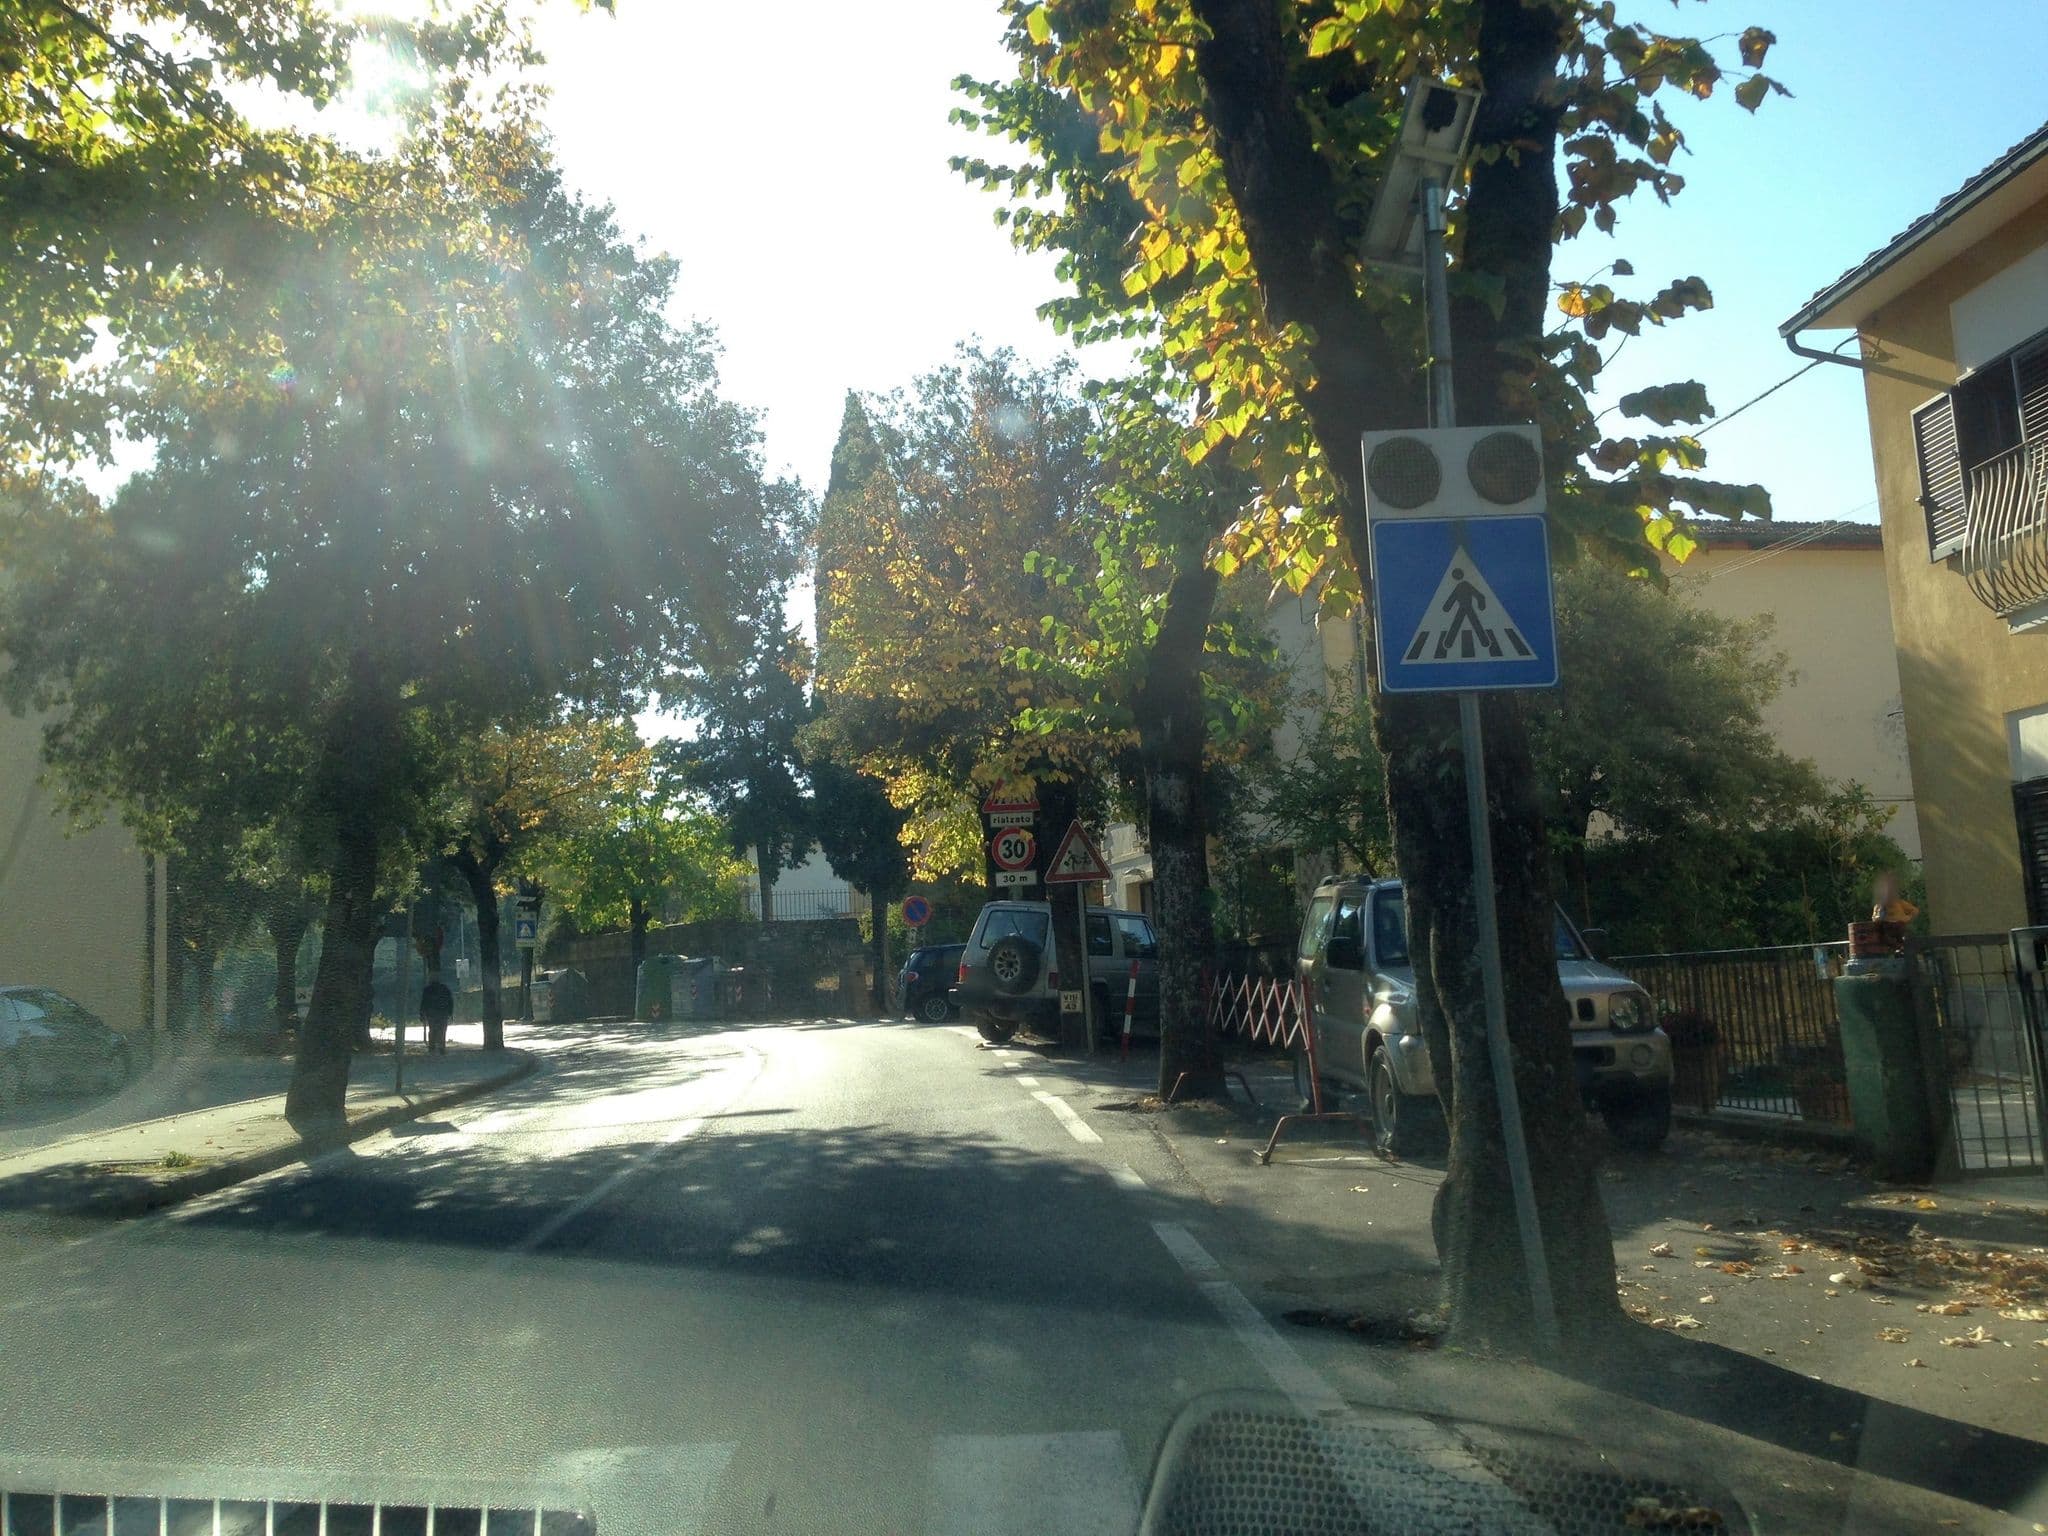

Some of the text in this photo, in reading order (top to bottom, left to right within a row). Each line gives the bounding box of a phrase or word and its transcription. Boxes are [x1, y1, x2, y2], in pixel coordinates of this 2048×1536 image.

[993, 816, 1031, 824] rialzato
[1002, 839, 1026, 859] 30
[1003, 875, 1016, 883] 30
